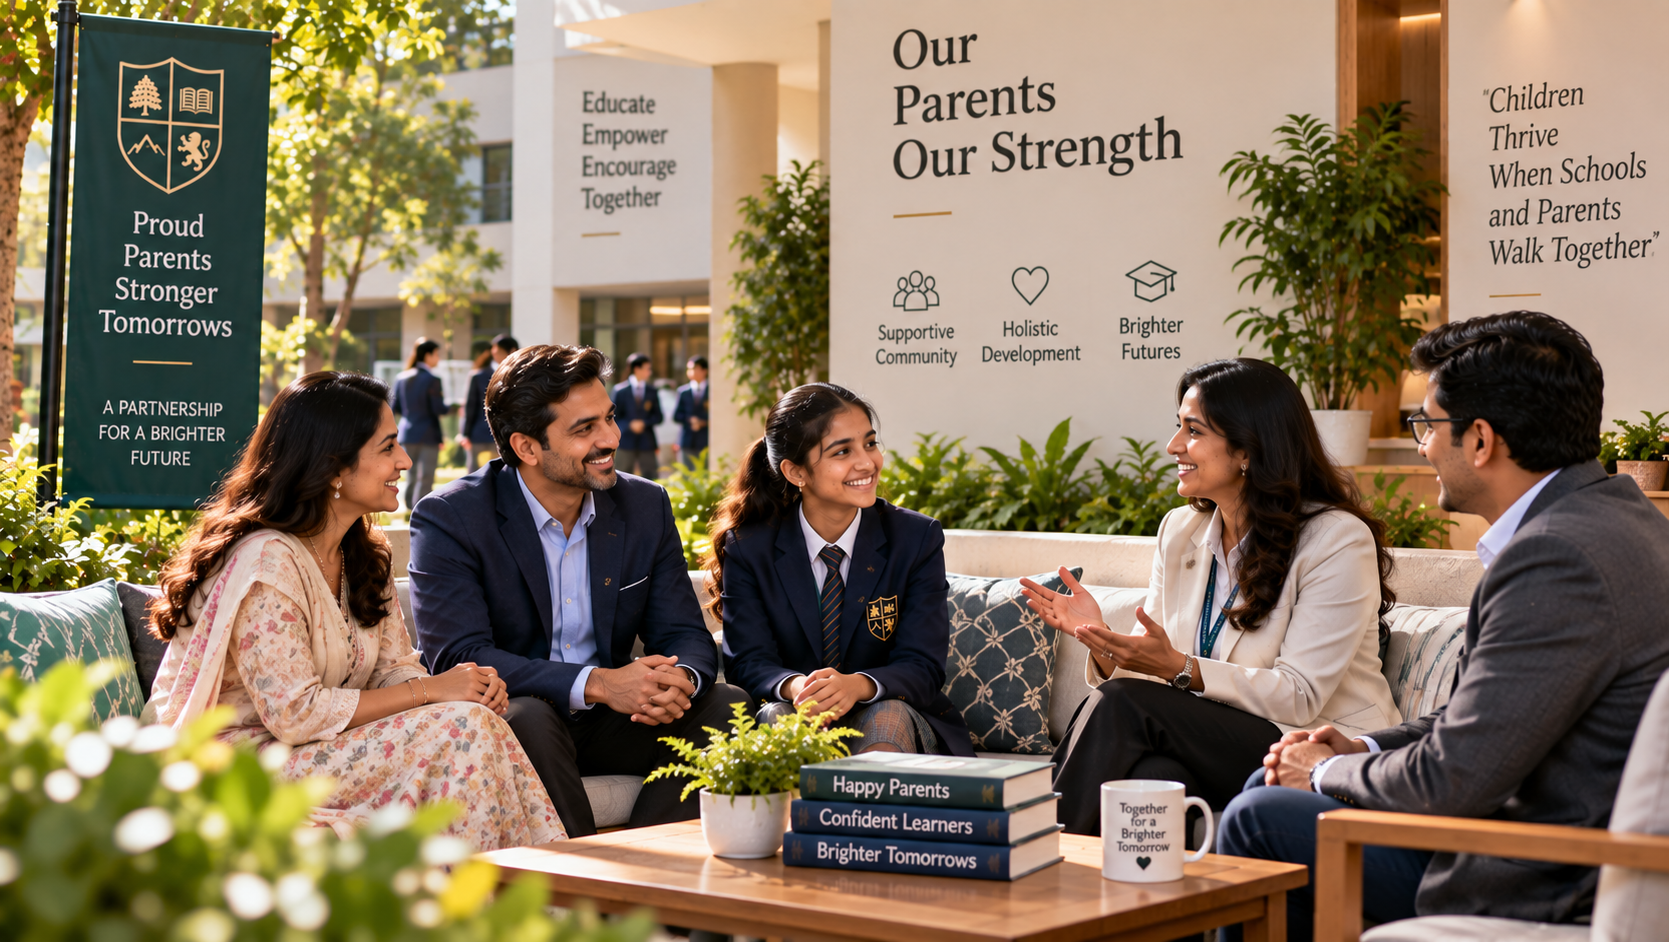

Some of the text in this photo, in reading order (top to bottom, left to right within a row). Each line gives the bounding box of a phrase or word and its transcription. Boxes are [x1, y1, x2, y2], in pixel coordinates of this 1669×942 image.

[892, 28, 978, 70] Our
[582, 90, 656, 115] Educate
[893, 75, 1056, 126] Parents
[582, 122, 669, 151] Empower
[893, 115, 1184, 180] Our Strength
[1488, 123, 1559, 151] Thrive
[582, 155, 677, 182] Encourage
[1488, 151, 1647, 189] When Schools
[581, 185, 662, 215] Together
[1488, 197, 1621, 228] and Parents
[132, 210, 205, 238] Proud
[123, 243, 212, 271] Parents
[1488, 236, 1544, 266] Walk
[114, 276, 219, 310] Stronger
[98, 309, 233, 338] Tomorrows
[878, 322, 955, 345] Supportive
[1003, 319, 1059, 338] Holistic
[1119, 315, 1184, 339] Brighter
[875, 347, 958, 369] Community
[981, 344, 1082, 367] Development
[1121, 342, 1181, 361] Futures
[102, 399, 224, 417] A PARTNERSHIP
[98, 424, 226, 442] FOR A BRIGHTER
[131, 450, 191, 467] FUTURE
[832, 775, 951, 800] Happy Parents
[819, 807, 974, 835] Confident Learners
[1119, 802, 1168, 818] Together
[1130, 816, 1157, 827] for a
[1116, 840, 1170, 853] Tomorrow
[1121, 827, 1167, 843] Brighter
[816, 841, 977, 870] Brighter Tomorrows
